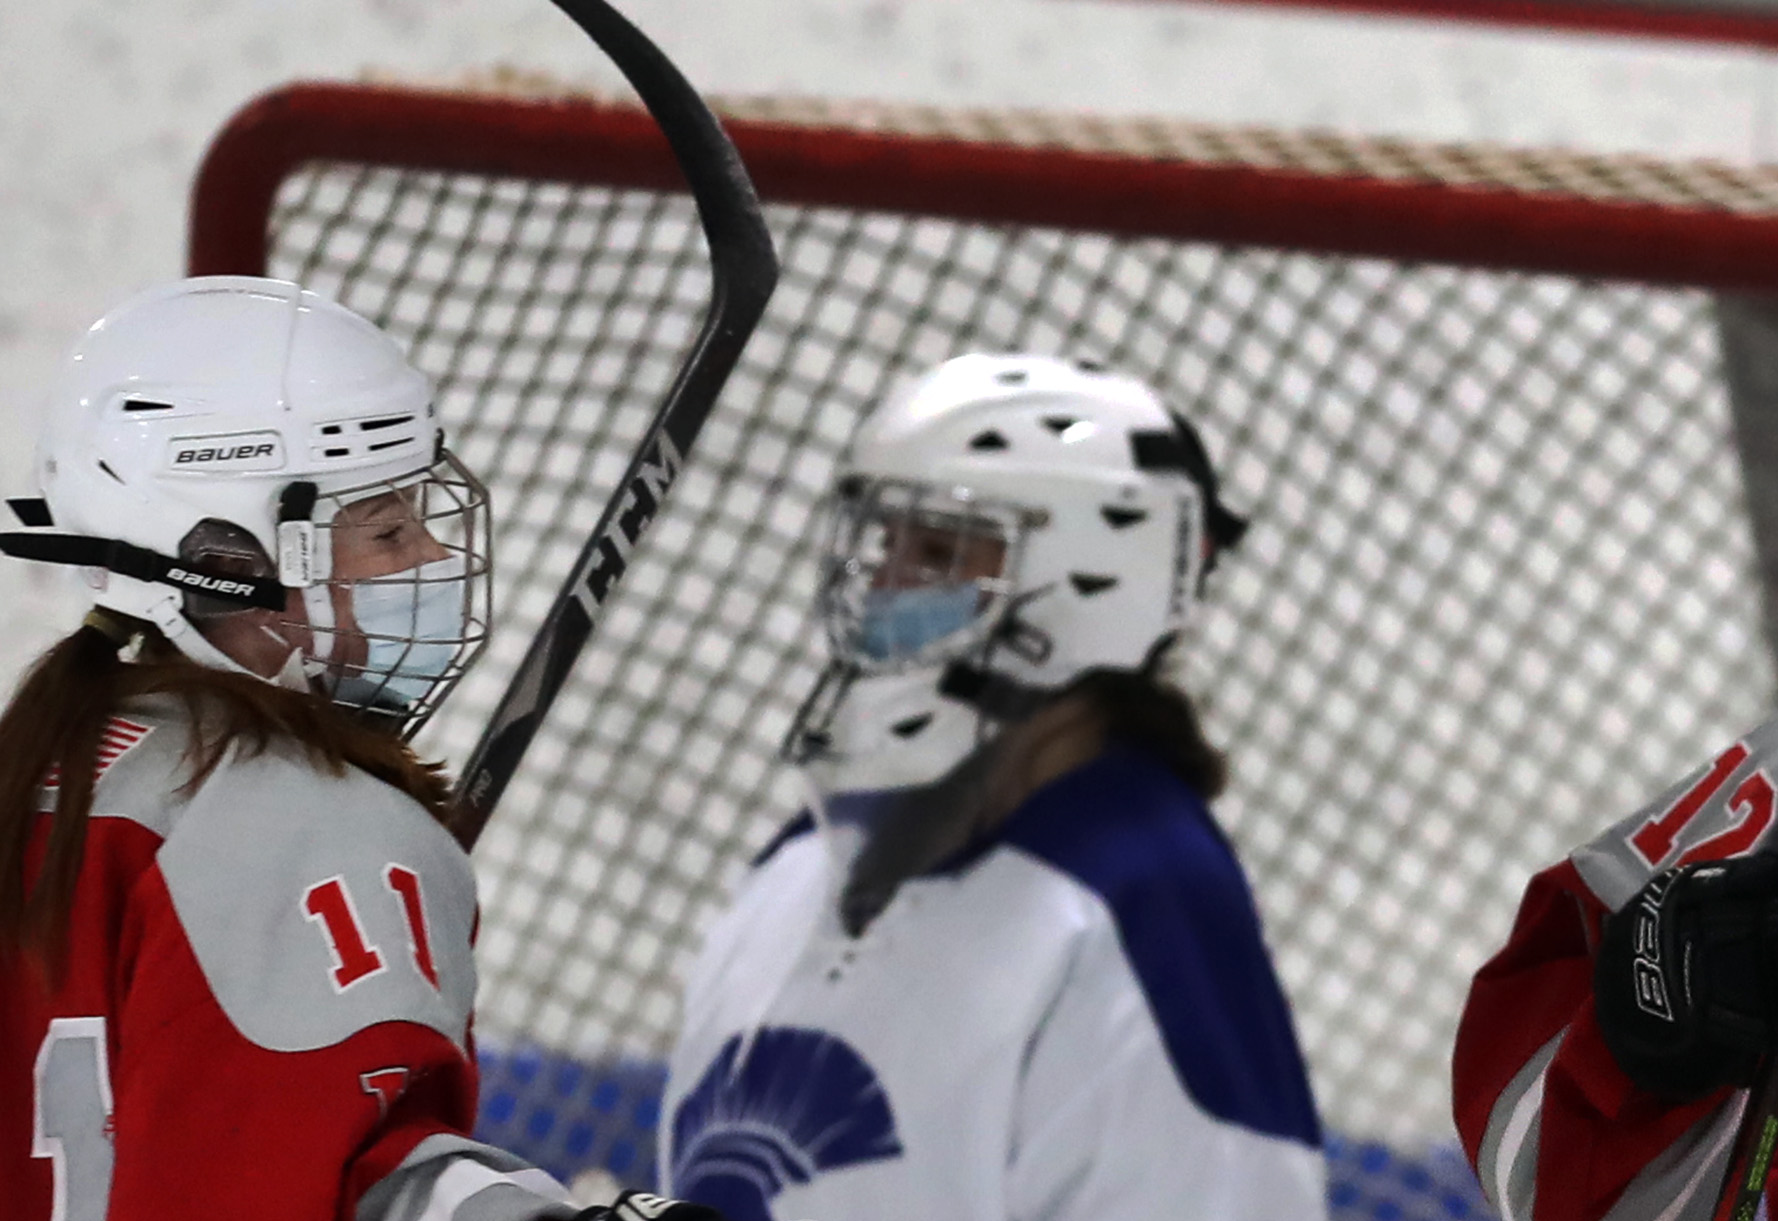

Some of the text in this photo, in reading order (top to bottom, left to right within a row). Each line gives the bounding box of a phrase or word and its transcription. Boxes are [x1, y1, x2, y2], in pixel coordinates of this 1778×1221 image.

[176, 443, 275, 463] BAUER
[166, 567, 256, 596] BAUER
[1624, 740, 1778, 871] 12
